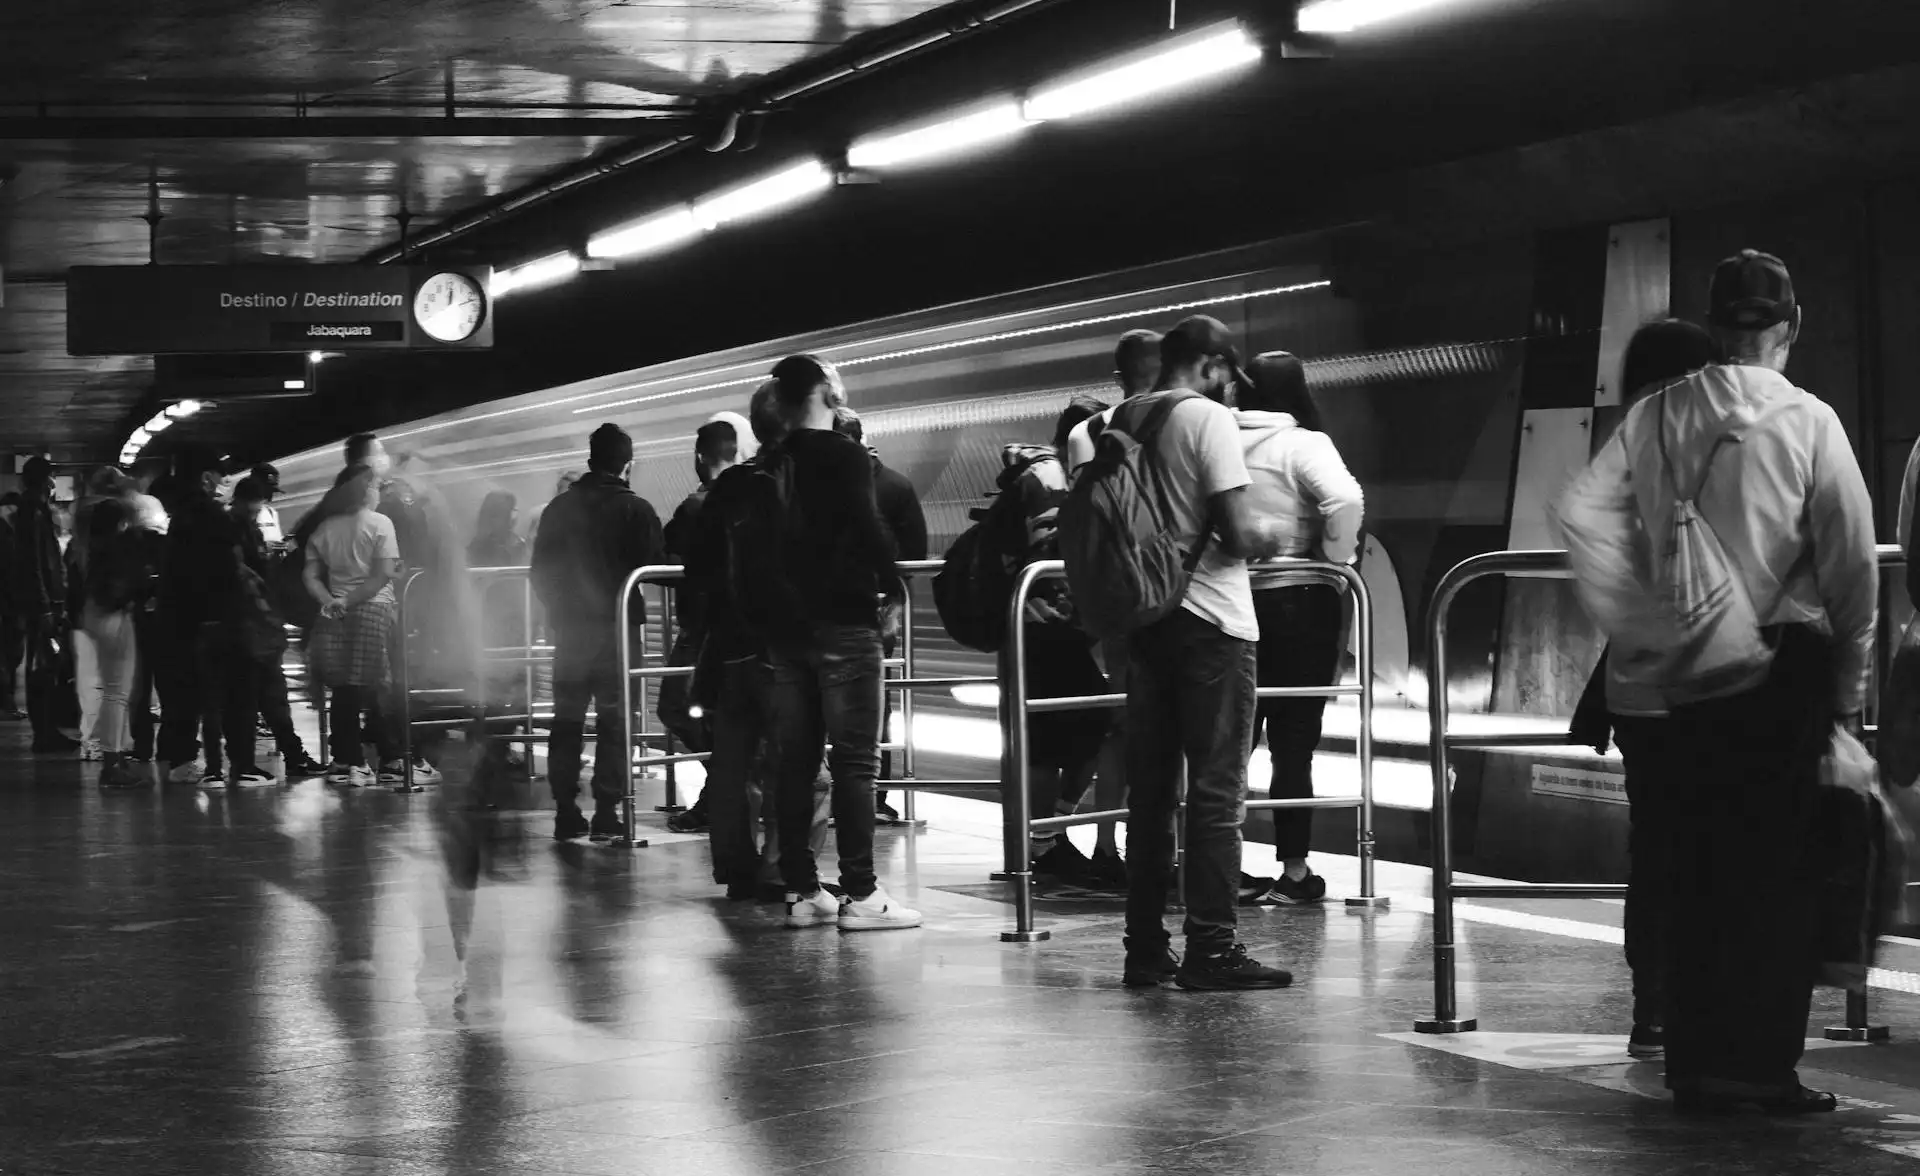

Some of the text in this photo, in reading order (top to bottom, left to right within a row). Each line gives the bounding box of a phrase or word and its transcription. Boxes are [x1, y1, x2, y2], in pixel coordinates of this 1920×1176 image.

[220, 292, 403, 308] Destino / Destination
[306, 324, 372, 338] Jabaquara
